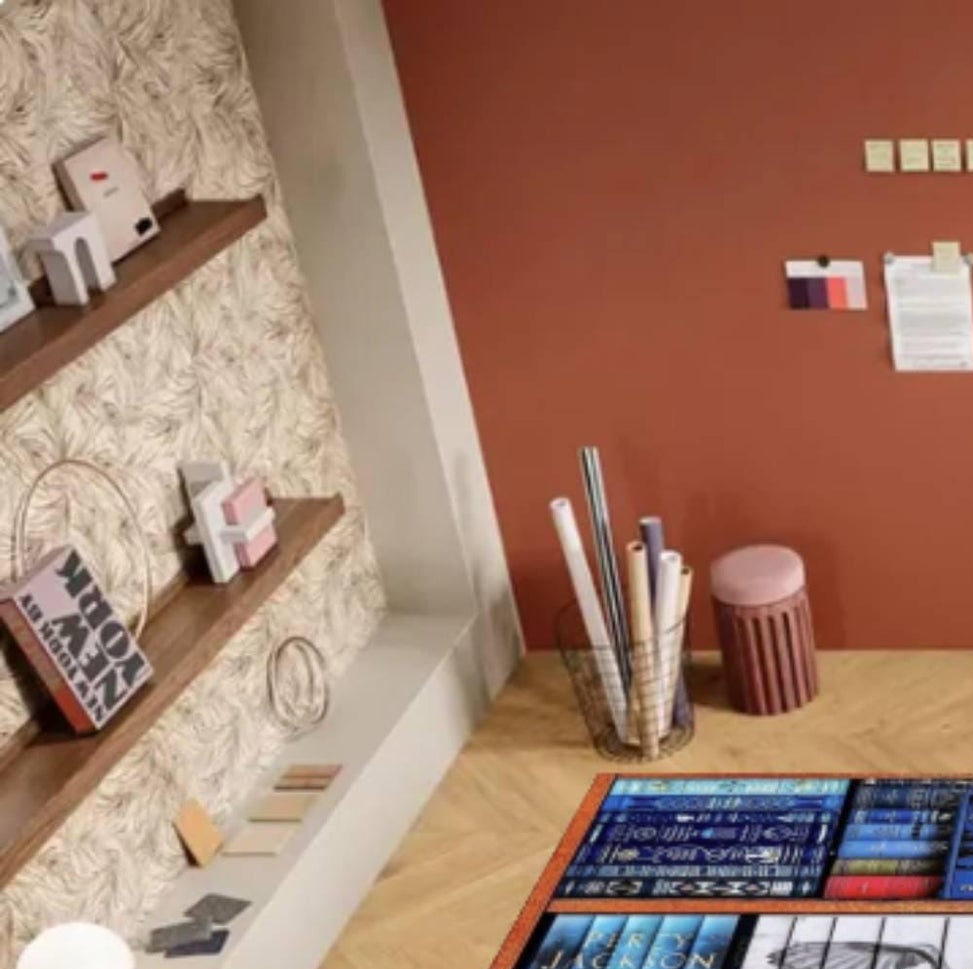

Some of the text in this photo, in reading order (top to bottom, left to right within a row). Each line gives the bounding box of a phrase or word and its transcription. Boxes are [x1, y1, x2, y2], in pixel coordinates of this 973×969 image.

[19, 593, 43, 623] BY
[56, 549, 145, 687] YORK
[39, 622, 77, 681] YORK
[52, 614, 127, 711] NEW
